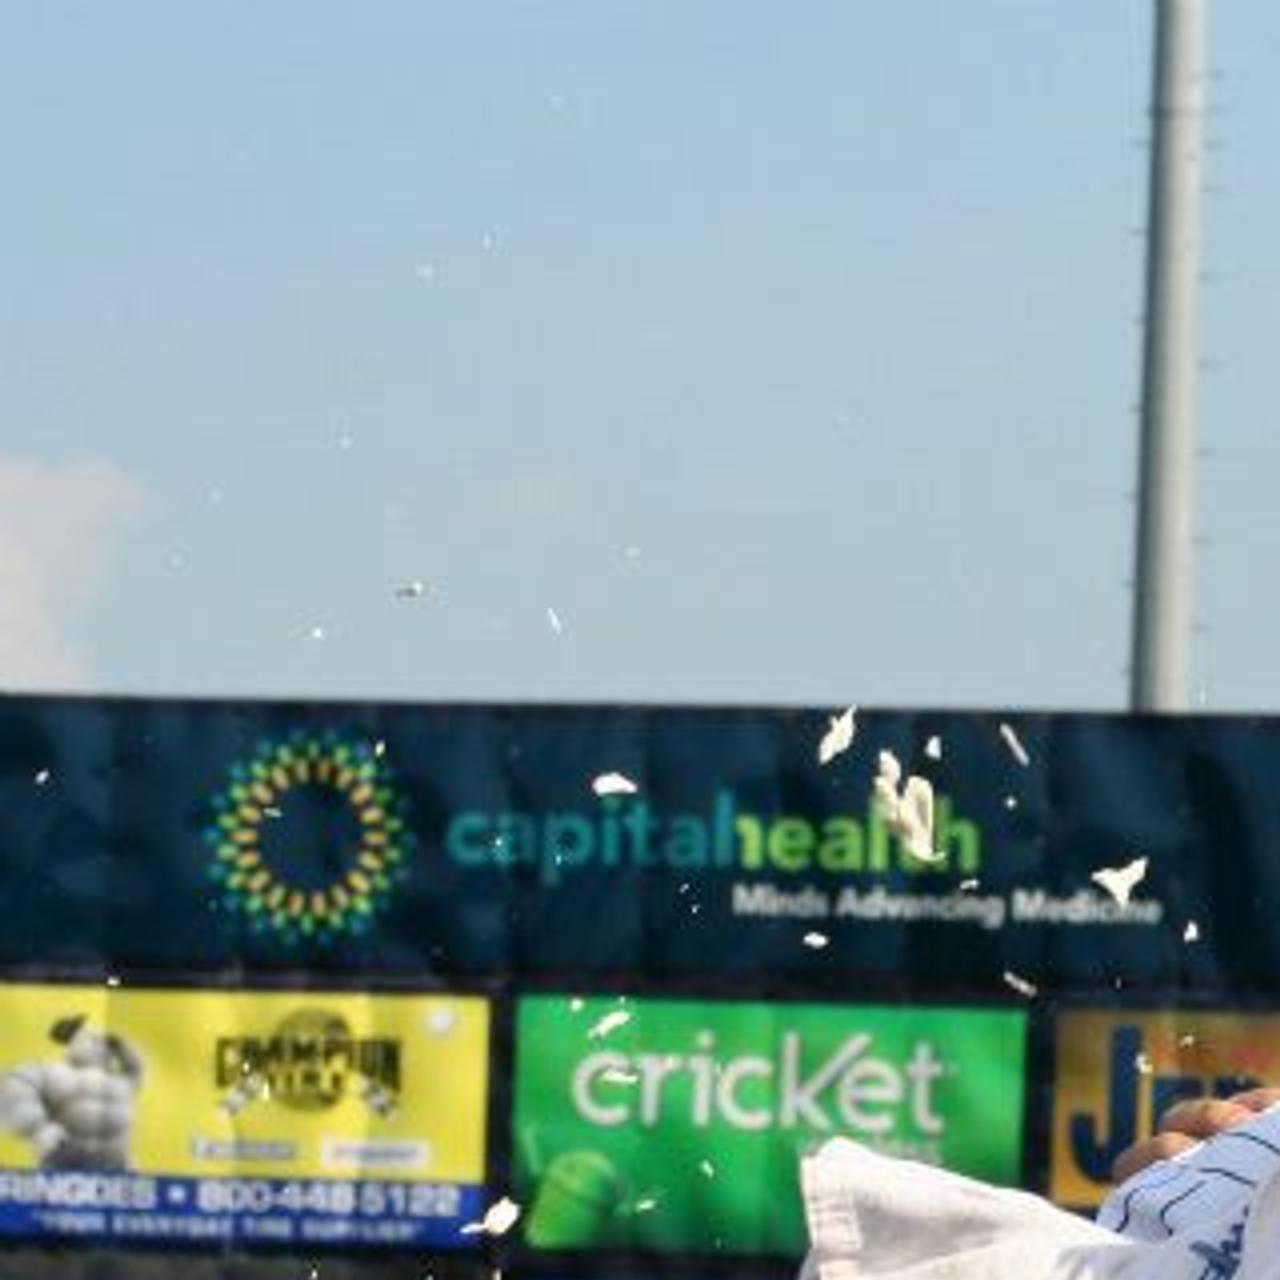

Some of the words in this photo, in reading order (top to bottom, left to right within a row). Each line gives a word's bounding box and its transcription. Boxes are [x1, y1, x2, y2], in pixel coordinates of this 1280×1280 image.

[733, 883, 828, 918] Minds
[836, 887, 1001, 928] Advancing
[1012, 890, 1163, 925] Medicine
[571, 1031, 945, 1132] cricket
